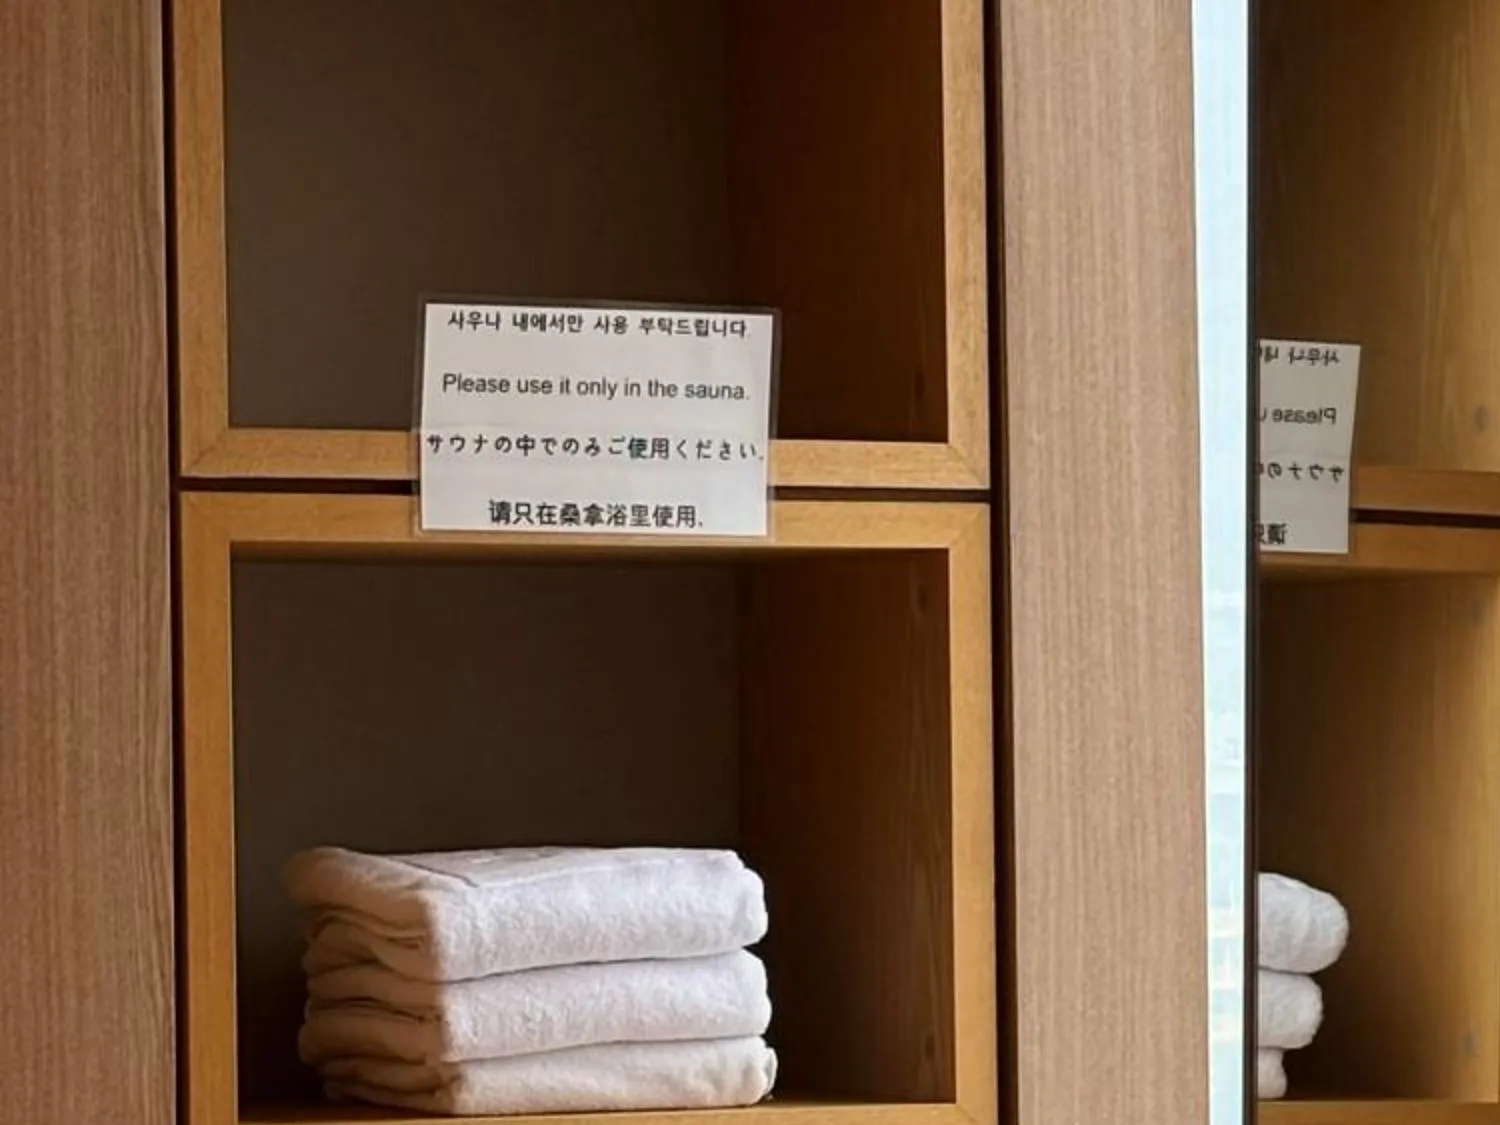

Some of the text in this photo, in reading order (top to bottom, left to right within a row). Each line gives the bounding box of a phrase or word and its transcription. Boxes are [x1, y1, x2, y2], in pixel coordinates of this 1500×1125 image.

[447, 310, 501, 331] 사우나
[511, 312, 584, 333] 내에서만
[593, 315, 629, 335] 사용
[442, 372, 750, 401] Please use it only in the sauna.
